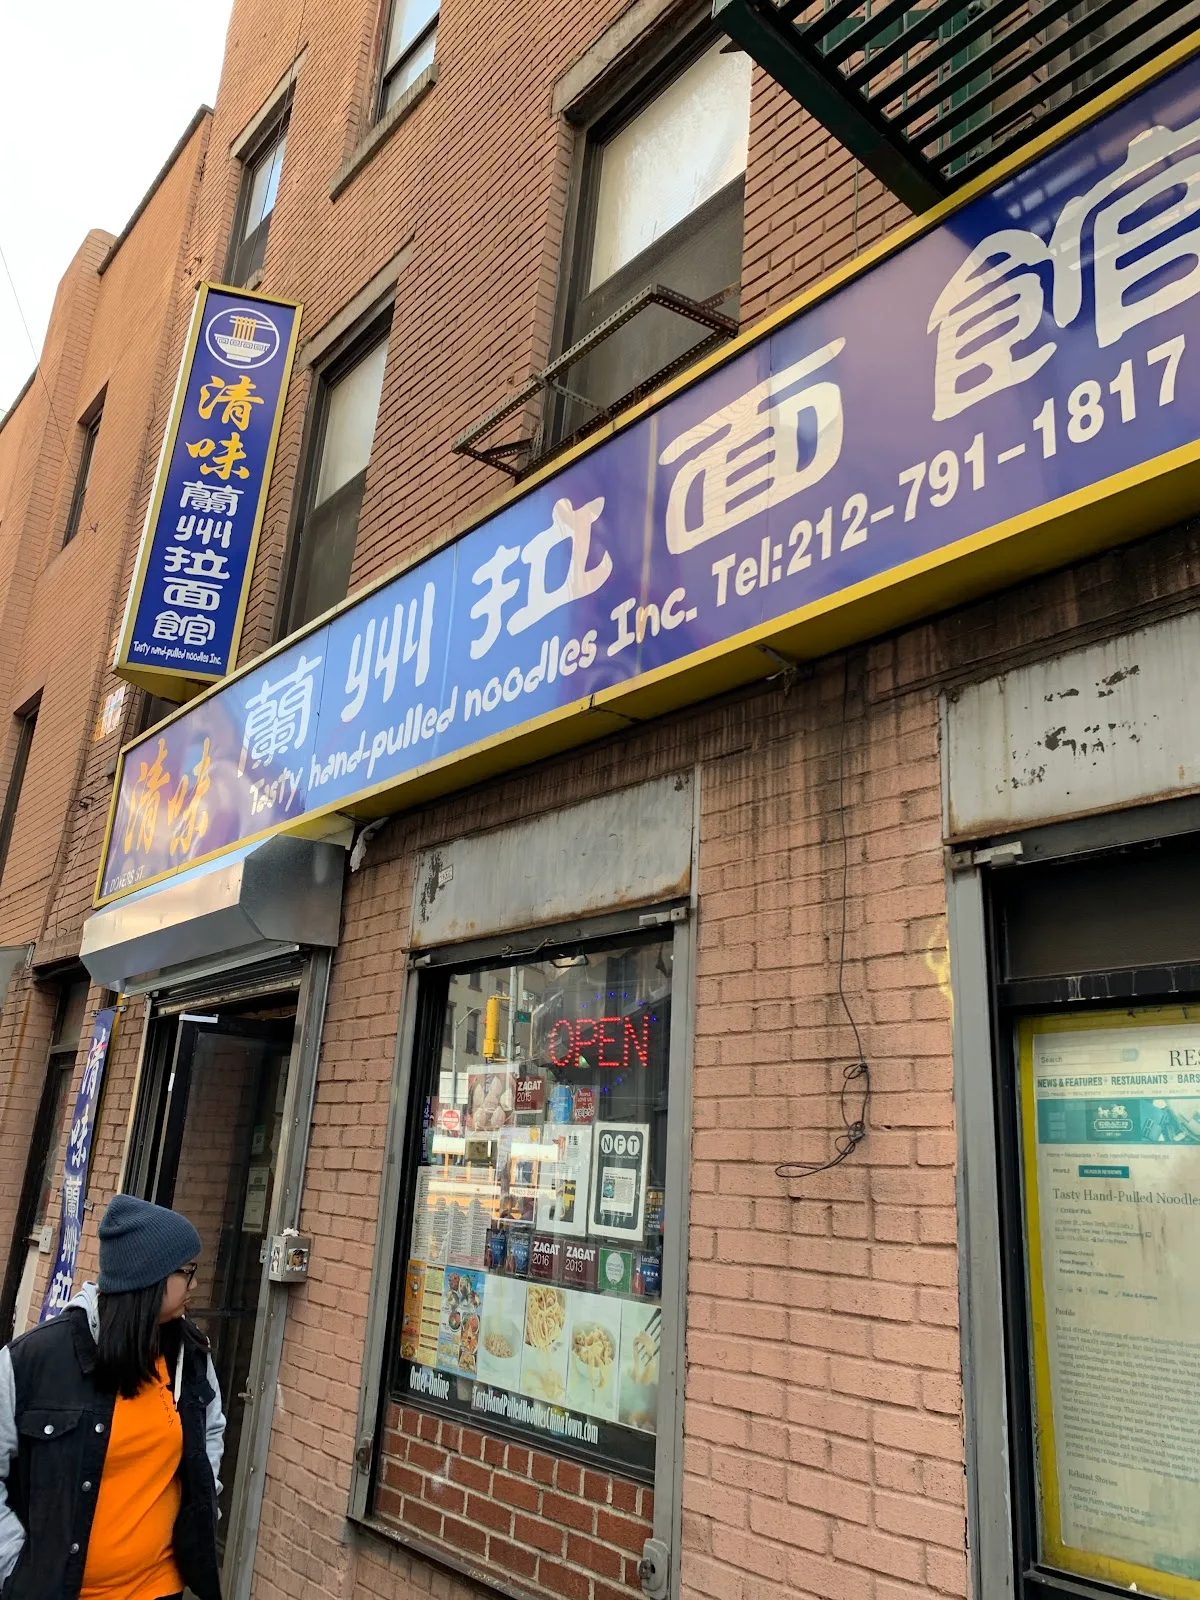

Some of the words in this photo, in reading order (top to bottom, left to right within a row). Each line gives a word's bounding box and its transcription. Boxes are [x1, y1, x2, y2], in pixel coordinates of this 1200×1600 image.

[184, 374, 265, 481] 清味
[133, 640, 151, 656] Tasty
[186, 651, 209, 662] noodles
[209, 653, 222, 665] Inc.
[249, 766, 303, 815] Tasty
[308, 685, 459, 791] hand-pulled
[464, 629, 597, 721] noodles
[607, 587, 697, 657] Inc.
[124, 737, 211, 856] 清味
[550, 1015, 649, 1067] OPEN
[1169, 1049, 1200, 1067] RE
[517, 1080, 543, 1091] ZAGAT
[1037, 1077, 1058, 1088] NEWS
[1059, 1078, 1064, 1087] &
[1065, 1076, 1103, 1087] FEATURES
[1111, 1074, 1168, 1085] RESTAURANTS
[1177, 1073, 1200, 1083] BARS
[516, 1091, 532, 1102] 2015
[602, 1136, 638, 1154] NFT
[1052, 1187, 1081, 1202] Tasty
[1083, 1189, 1153, 1204] Hand-Pulled
[1156, 1192, 1200, 1206] Noodle
[533, 1241, 560, 1256] ZAGAT
[566, 1246, 596, 1261] ZAGAT
[532, 1253, 550, 1266] 2016
[565, 1259, 583, 1272] 2013
[1055, 1307, 1075, 1316] Profile
[410, 1365, 427, 1393] Order
[428, 1371, 450, 1400] Online
[1068, 1469, 1093, 1481] Related
[1095, 1475, 1118, 1486] Stories
